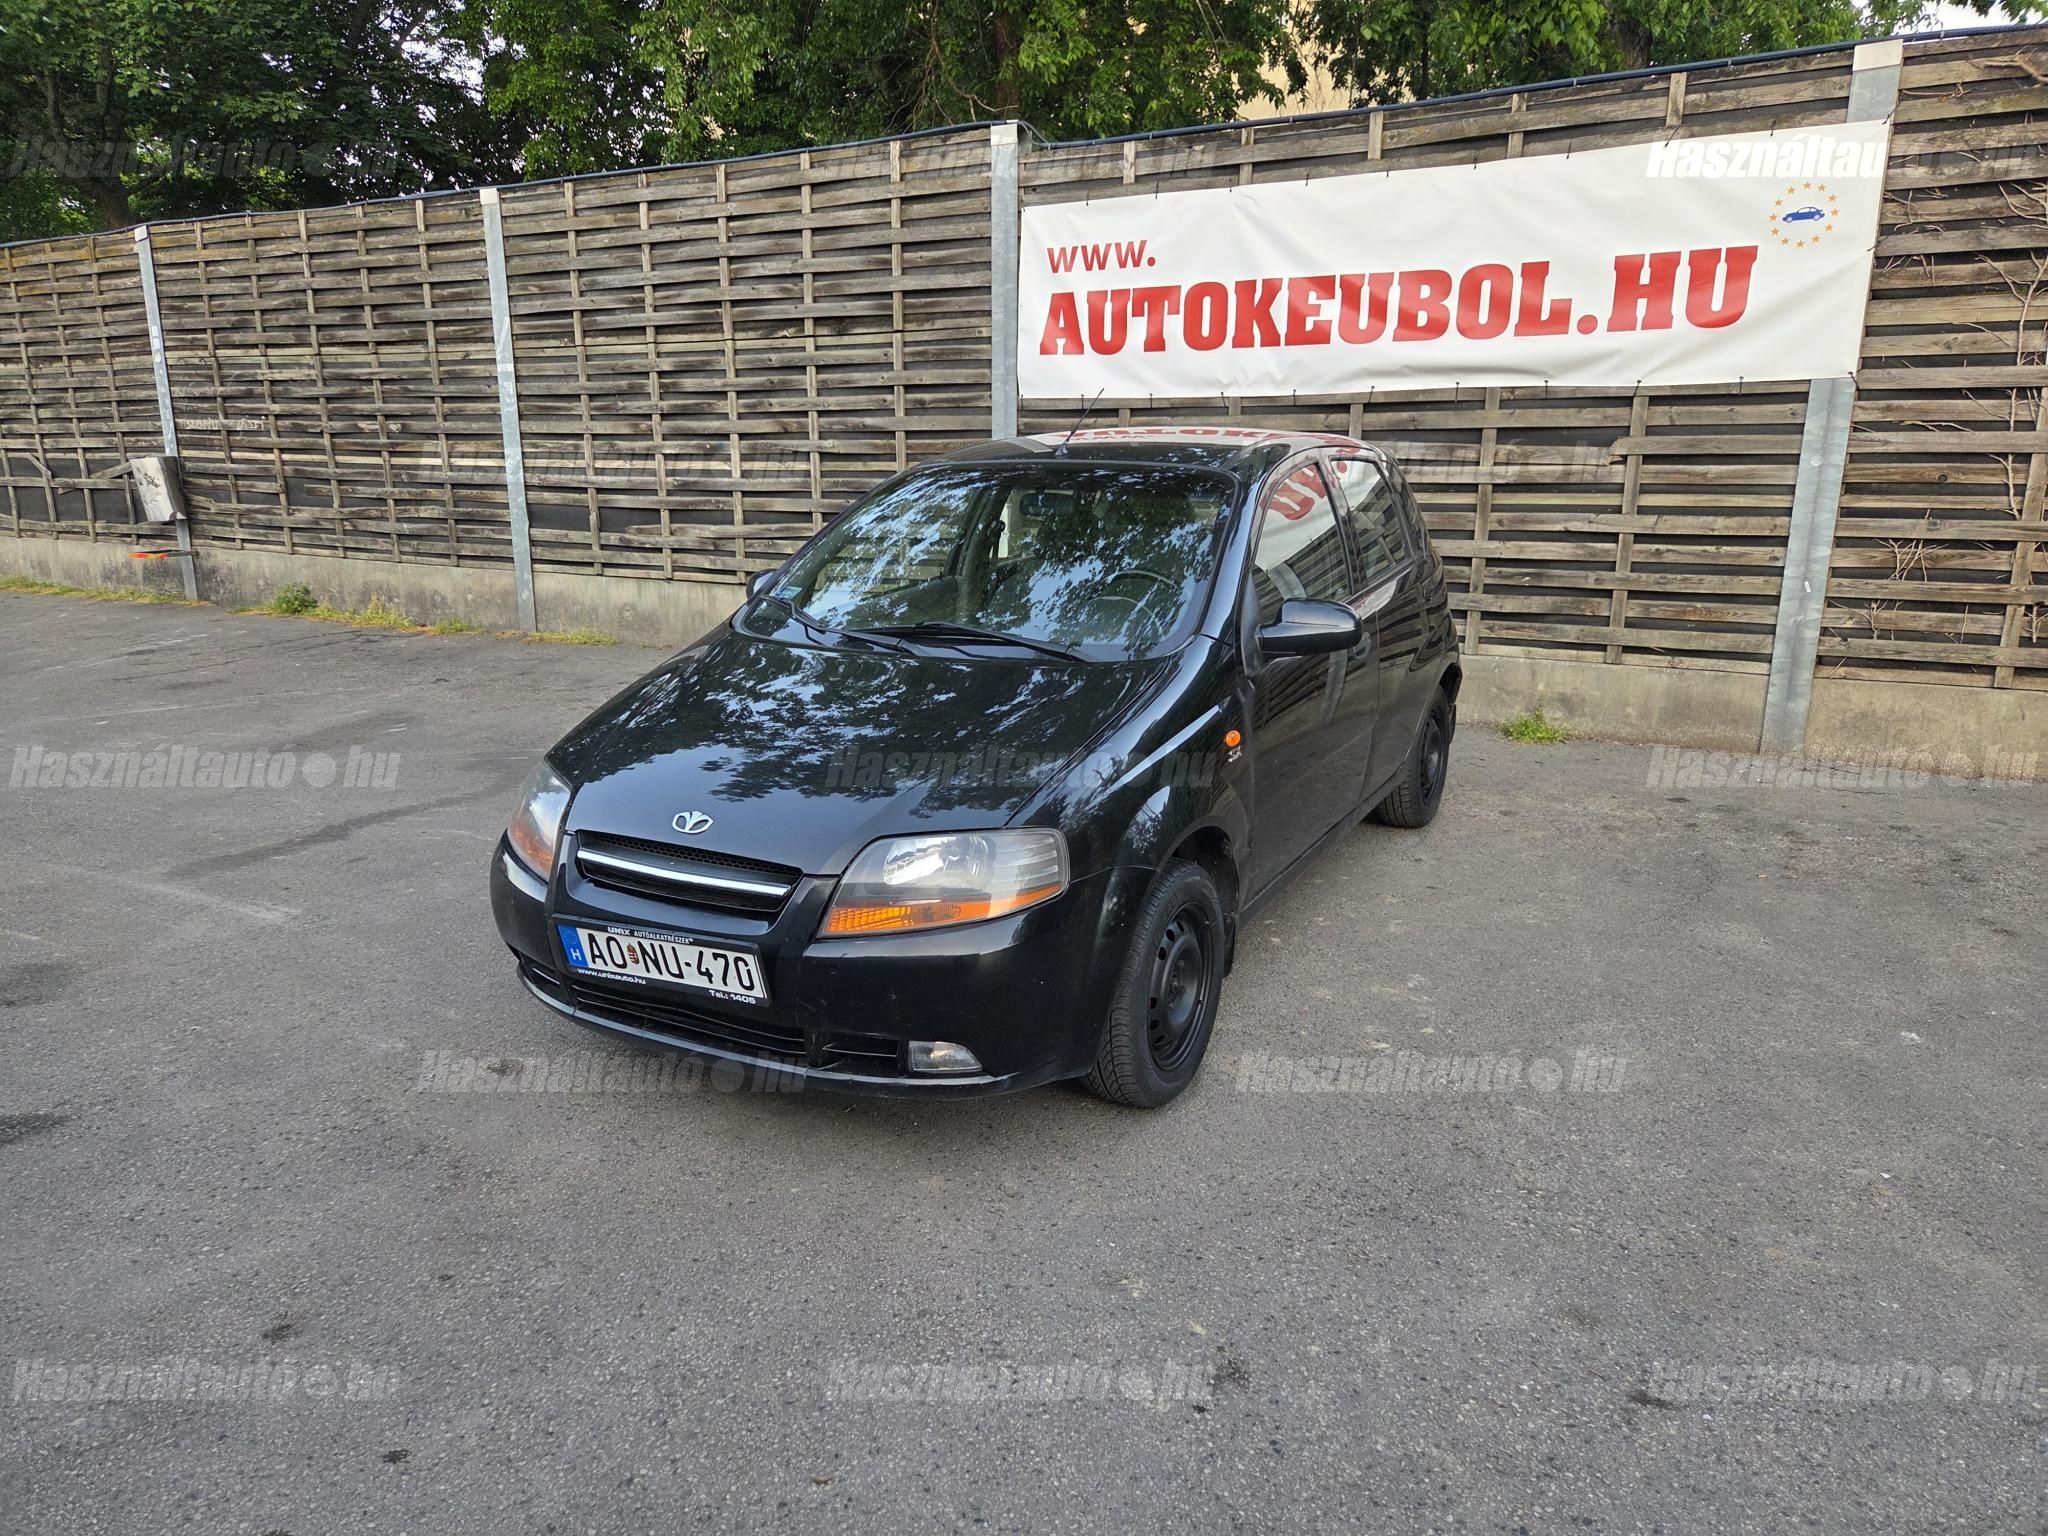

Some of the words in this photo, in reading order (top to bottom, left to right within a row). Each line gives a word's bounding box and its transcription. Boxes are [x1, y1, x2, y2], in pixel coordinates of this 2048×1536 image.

[1047, 240, 1156, 273] www.
[1040, 245, 1758, 355] AUTOKEUBOL.HU
[607, 926, 631, 936] UNIX
[571, 948, 582, 961] H
